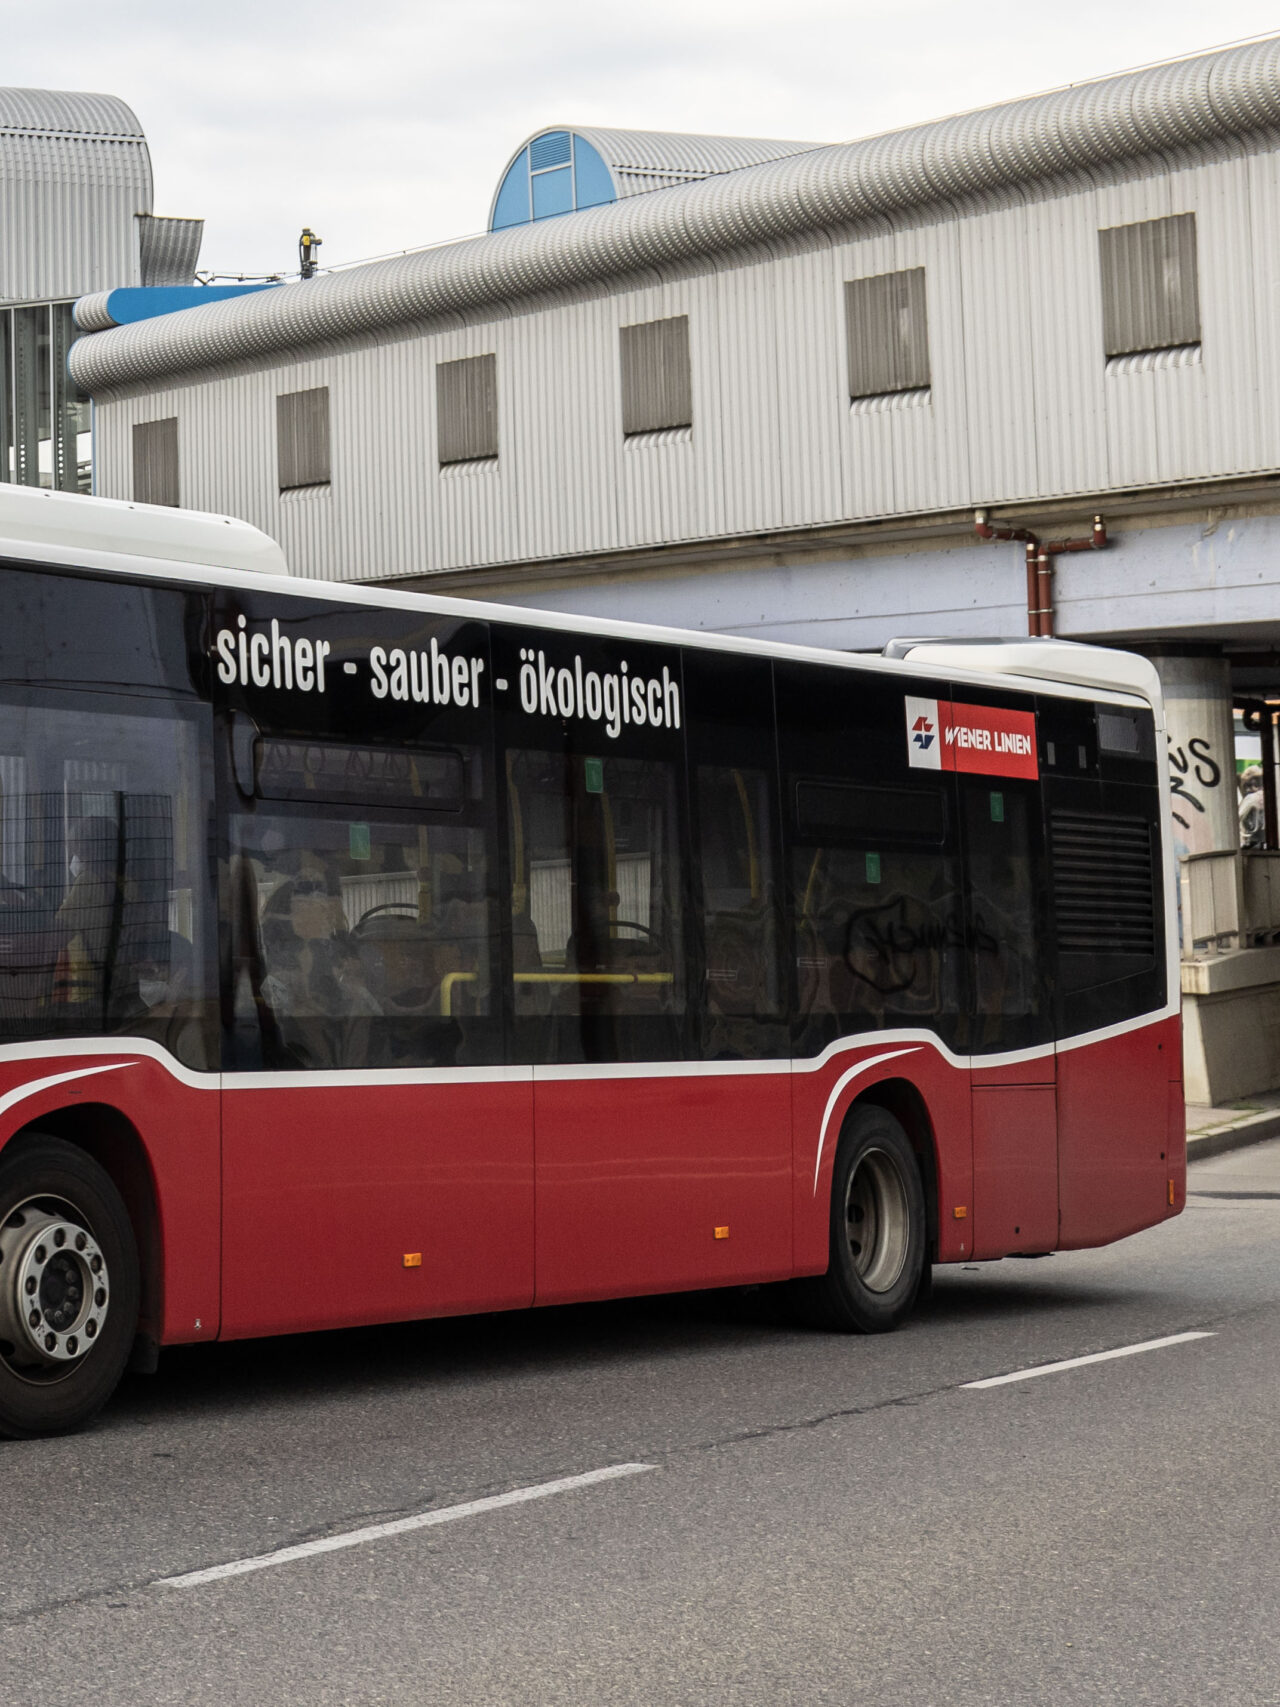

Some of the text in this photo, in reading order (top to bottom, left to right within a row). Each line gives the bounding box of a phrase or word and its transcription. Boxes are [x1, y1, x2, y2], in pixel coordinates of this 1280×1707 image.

[216, 613, 331, 694] sicher
[369, 636, 485, 709] sauber
[519, 647, 682, 740] ökologisch
[944, 724, 1033, 756] WIENER LINIEN
